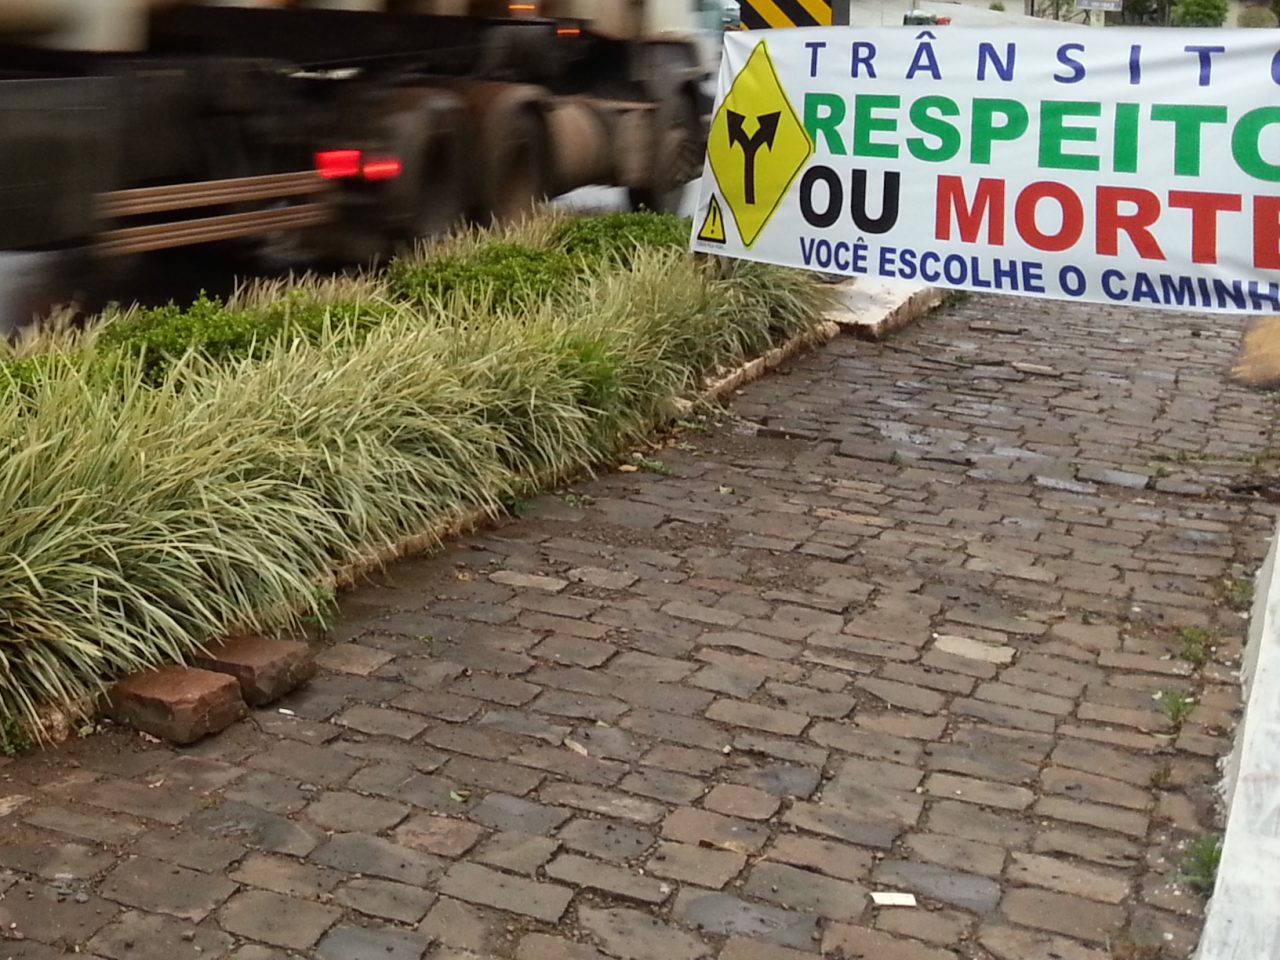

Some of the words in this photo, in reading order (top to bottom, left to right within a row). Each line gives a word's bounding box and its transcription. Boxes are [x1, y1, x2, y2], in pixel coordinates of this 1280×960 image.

[805, 31, 1280, 87] TRÂNSIT
[803, 93, 1280, 182] RESPEITO
[799, 165, 900, 234] OU
[800, 237, 868, 274] VOCÊ
[879, 247, 1046, 293] ESCOLHE
[1059, 265, 1086, 297] O
